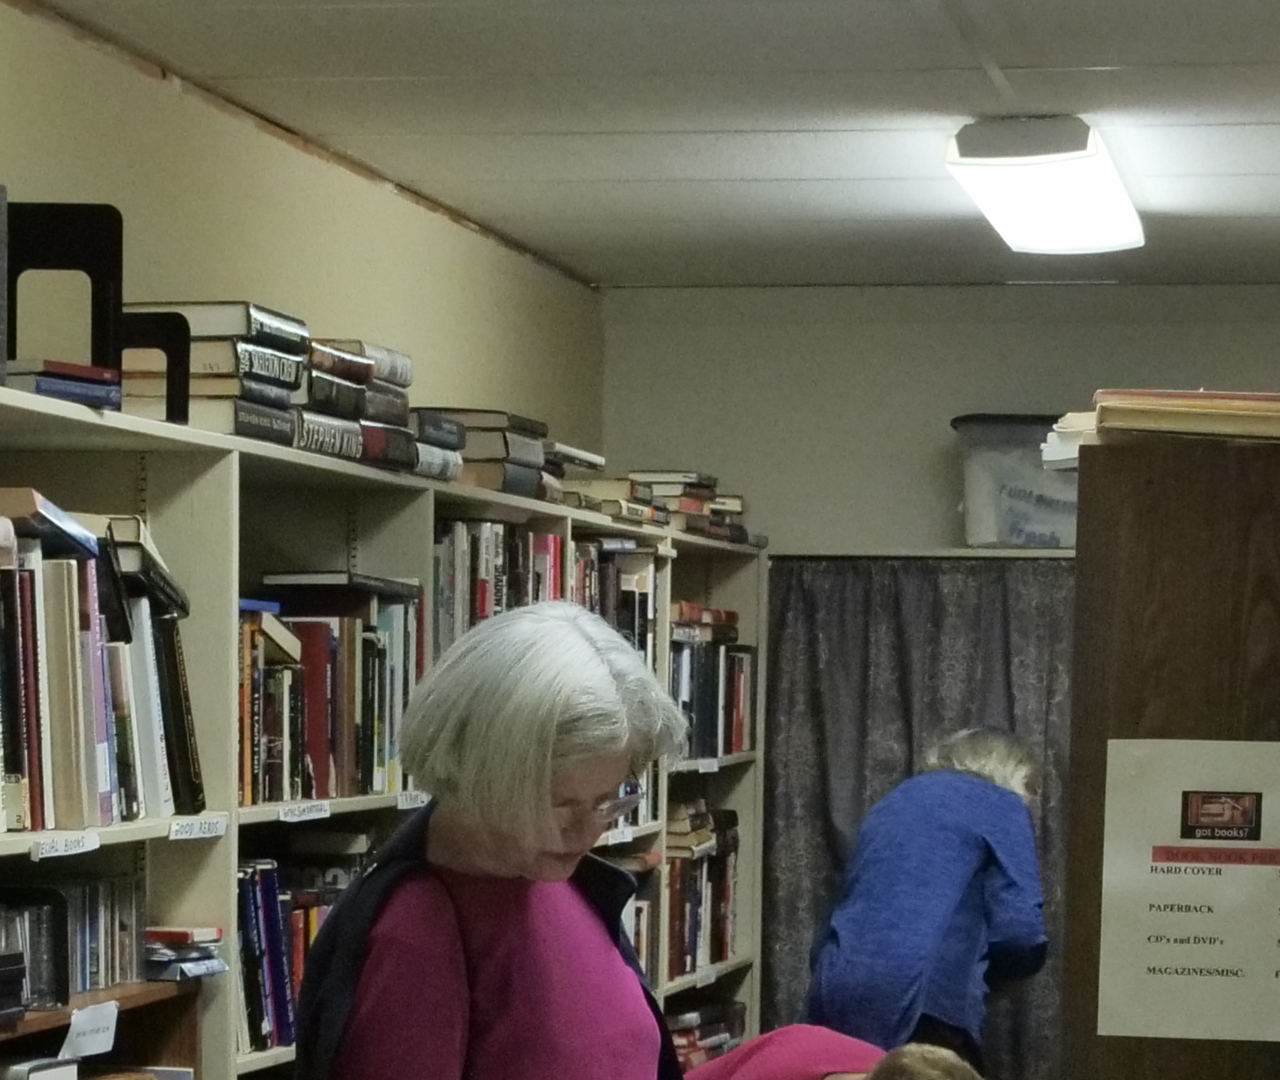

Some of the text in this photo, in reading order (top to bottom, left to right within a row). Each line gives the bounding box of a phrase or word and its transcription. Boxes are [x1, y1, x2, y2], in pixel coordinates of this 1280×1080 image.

[300, 421, 341, 455] STEPHEN
[341, 432, 363, 459] KING
[1194, 826, 1250, 839] got books?
[1150, 865, 1223, 877] HARD COVER
[1148, 903, 1215, 914] PAPERBACK
[1146, 935, 1171, 945] CD's
[1193, 936, 1224, 946] DVD's
